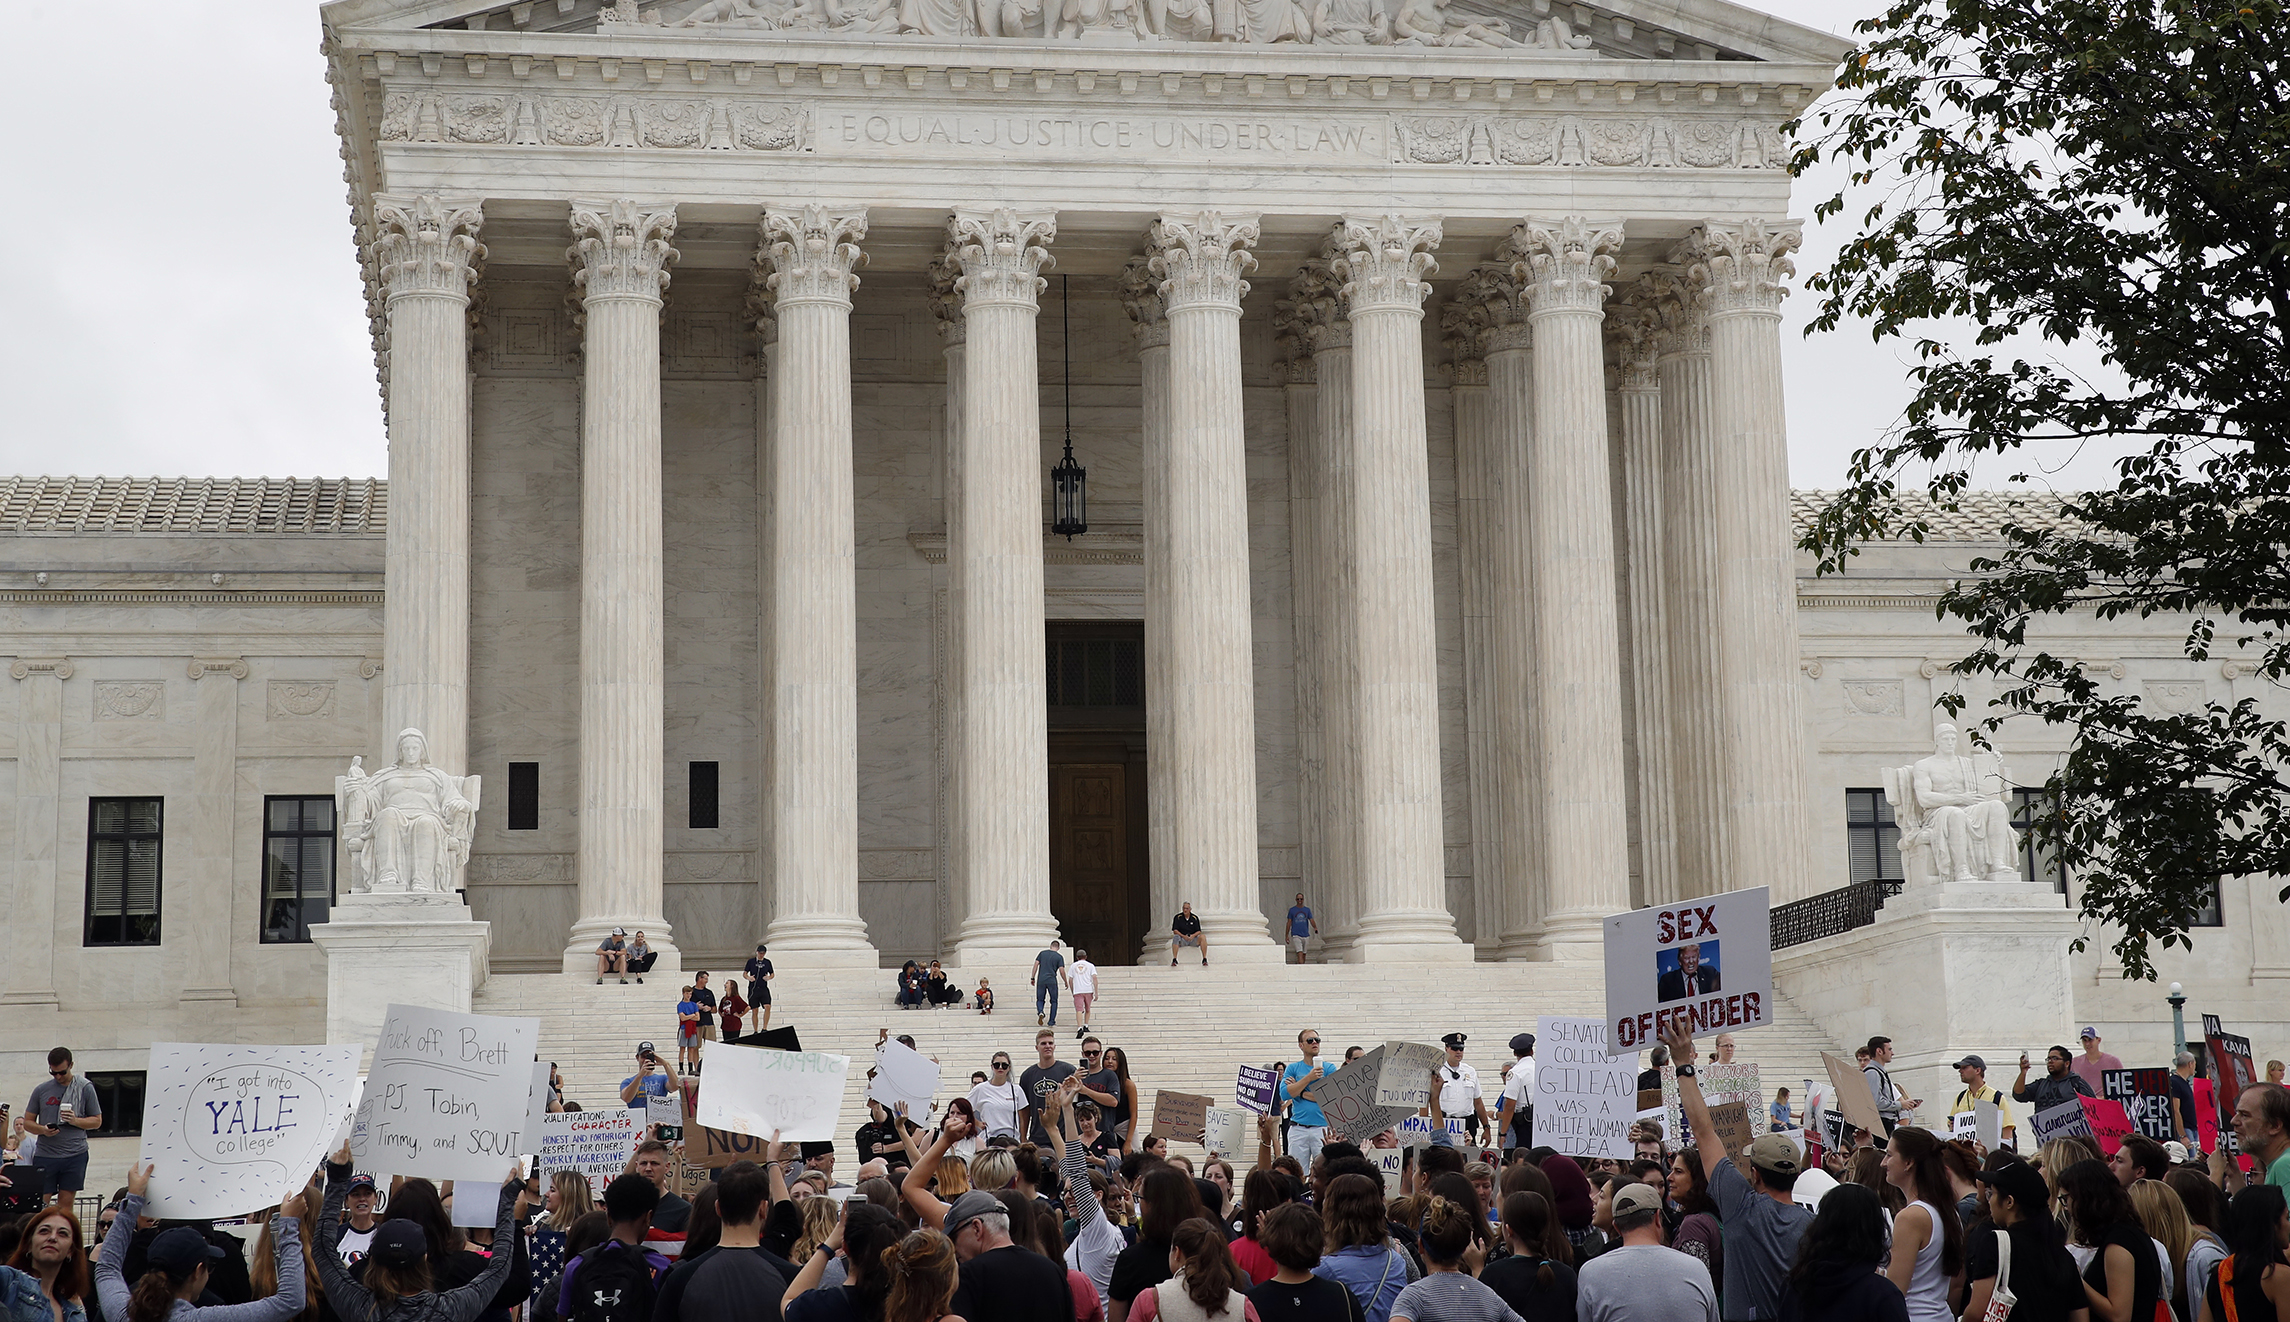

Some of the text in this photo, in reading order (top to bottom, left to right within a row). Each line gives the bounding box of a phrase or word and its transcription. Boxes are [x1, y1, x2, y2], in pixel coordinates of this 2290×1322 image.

[841, 115, 1366, 151] EQUAL JUSTICE UNDER LAW
[1656, 904, 1719, 944] SEX
[1617, 991, 1761, 1047] OFFENDER
[2222, 1039, 2250, 1057] KAVA
[1240, 1067, 1268, 1081] I BELIEVE
[1333, 1064, 1377, 1095] have
[1703, 1063, 1759, 1079] SURVIVORS
[237, 1070, 261, 1098] got
[267, 1072, 292, 1090] into
[1538, 1066, 1634, 1097] GILEAD
[2106, 1070, 2169, 1096] HE LIED
[1237, 1085, 1256, 1098] NO ON
[423, 1088, 480, 1120] Tobin,
[1237, 1094, 1270, 1111] KAVANAUGH
[1555, 1099, 1610, 1114] WAS A
[205, 1095, 300, 1134] YALE
[543, 1111, 606, 1124] QUALIFICATIONS
[1207, 1110, 1230, 1126] SAVE
[1324, 1096, 1360, 1129] NO
[571, 1119, 632, 1131] CHARACTER
[1358, 1114, 1392, 1140] calendar
[1536, 1113, 1584, 1135] WHITE
[375, 1123, 422, 1159] Timmy,
[433, 1135, 456, 1150] and
[543, 1131, 632, 1145] HONEST AND FORTHRIGHT
[580, 1144, 594, 1152] FOR
[595, 1142, 624, 1152] OTHERS
[1559, 1137, 1614, 1156] IDEA.
[576, 1151, 624, 1163] AGGRESSIVE
[1383, 1154, 1399, 1169] NO
